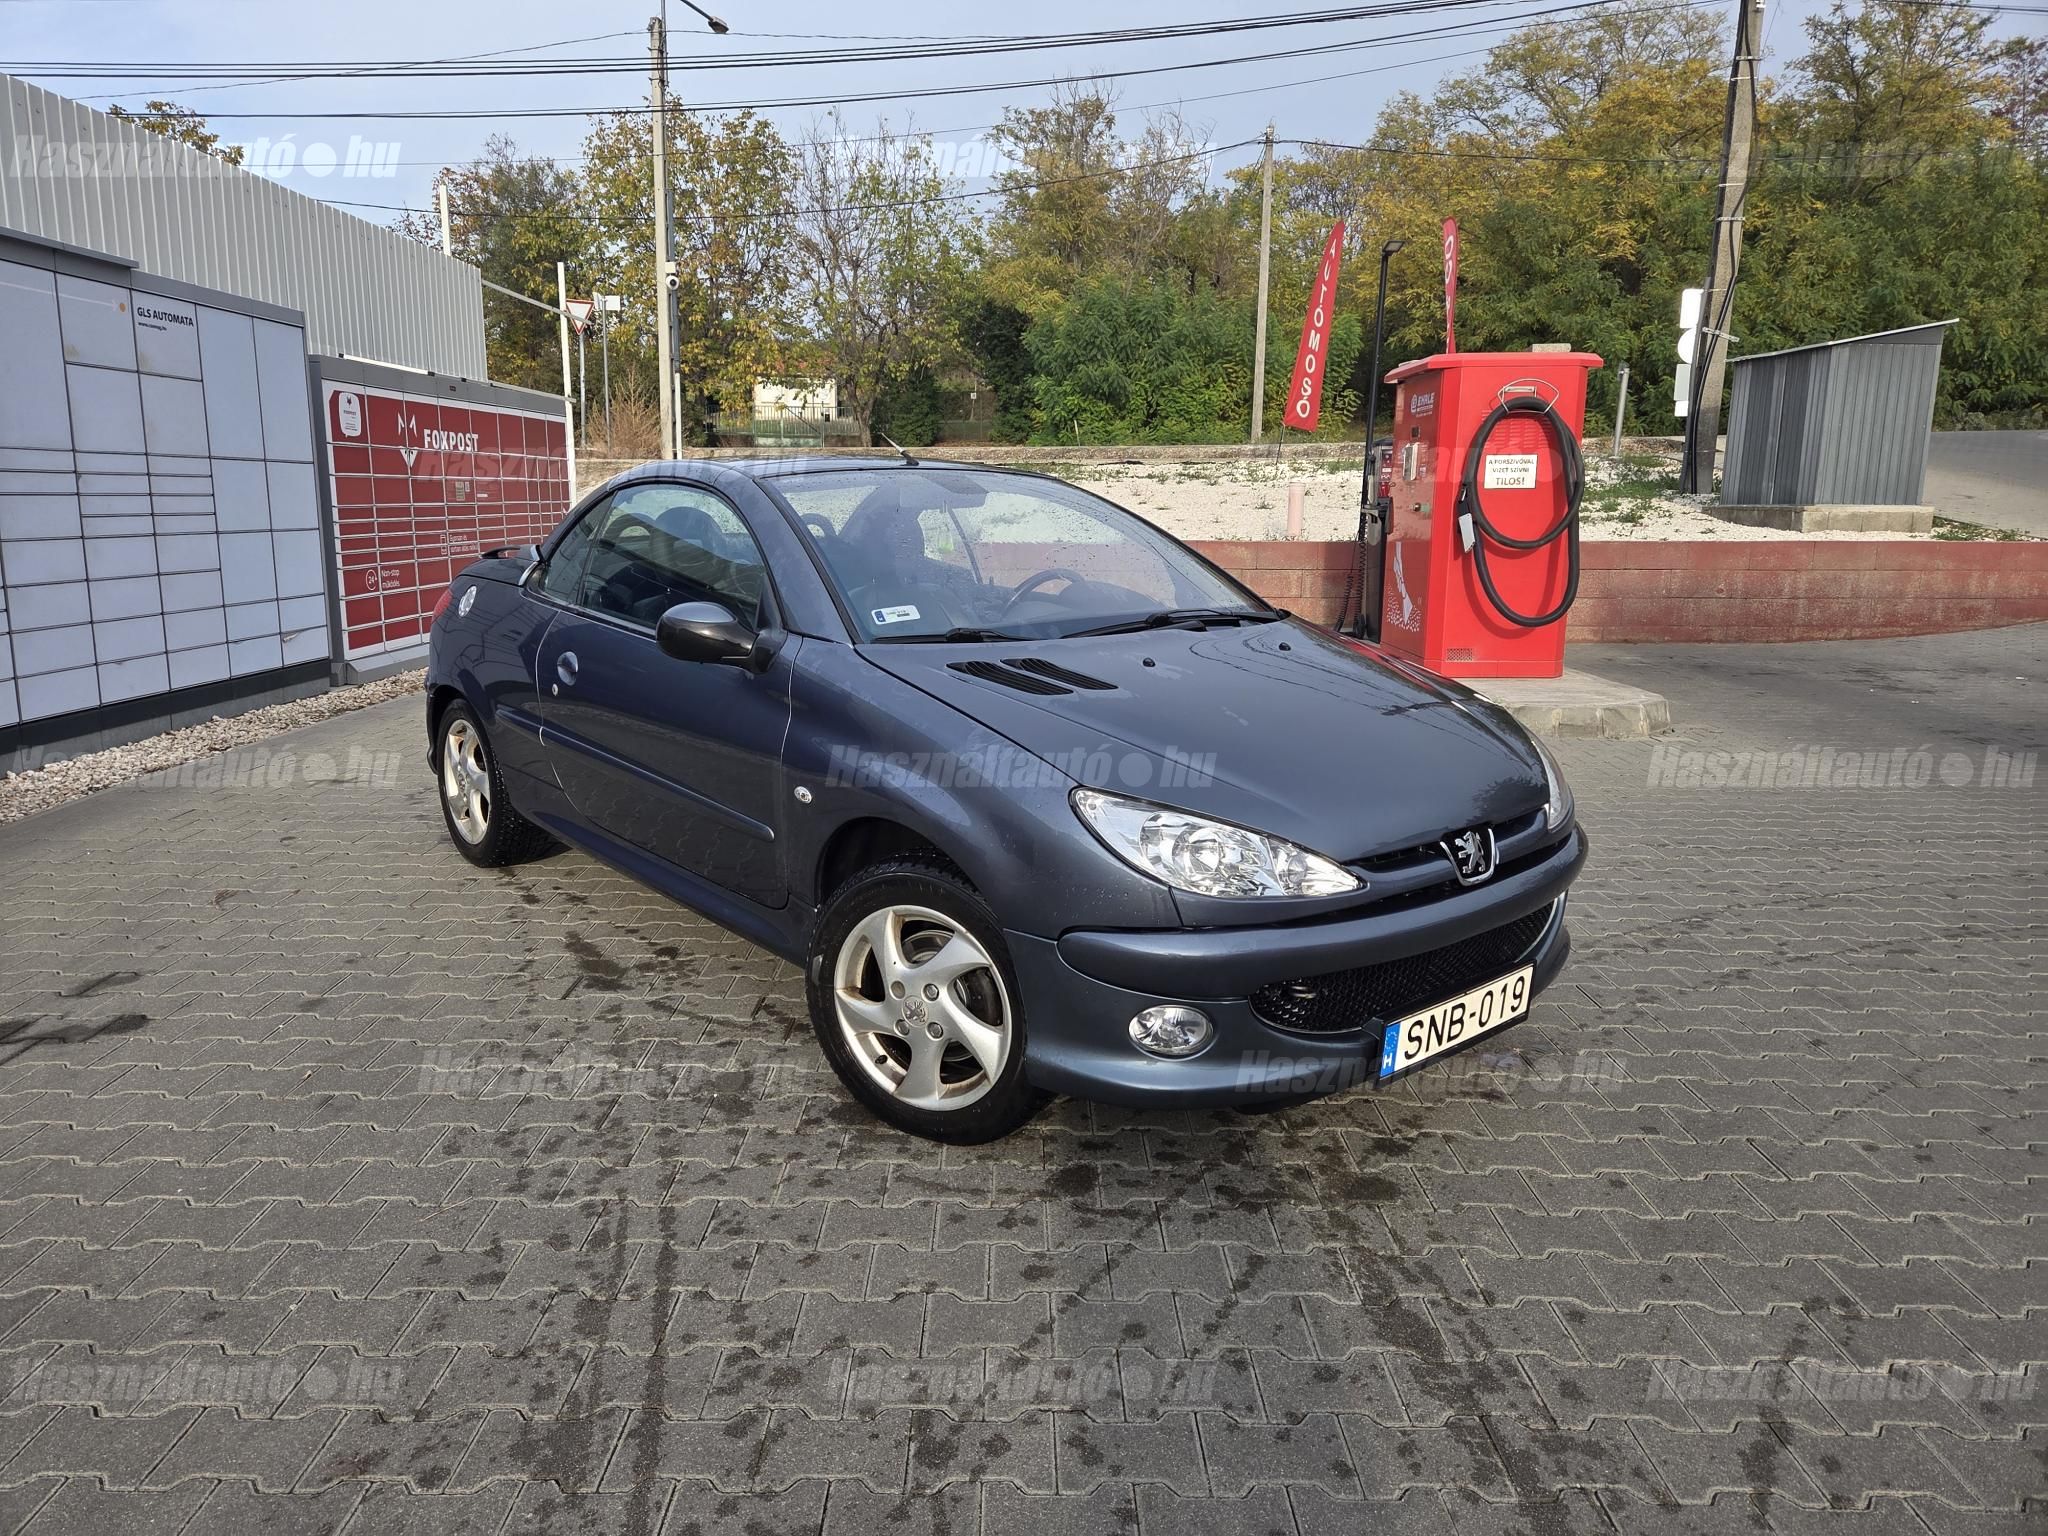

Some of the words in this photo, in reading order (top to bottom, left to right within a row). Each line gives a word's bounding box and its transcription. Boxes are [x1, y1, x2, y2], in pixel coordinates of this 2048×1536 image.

[137, 306, 152, 319] GLS
[153, 309, 194, 327] AUTOMATA
[423, 428, 479, 452] FOXPOST
[1495, 477, 1525, 486] TILOS!
[1404, 975, 1526, 1061] SNB-019
[1382, 1053, 1392, 1070] H
